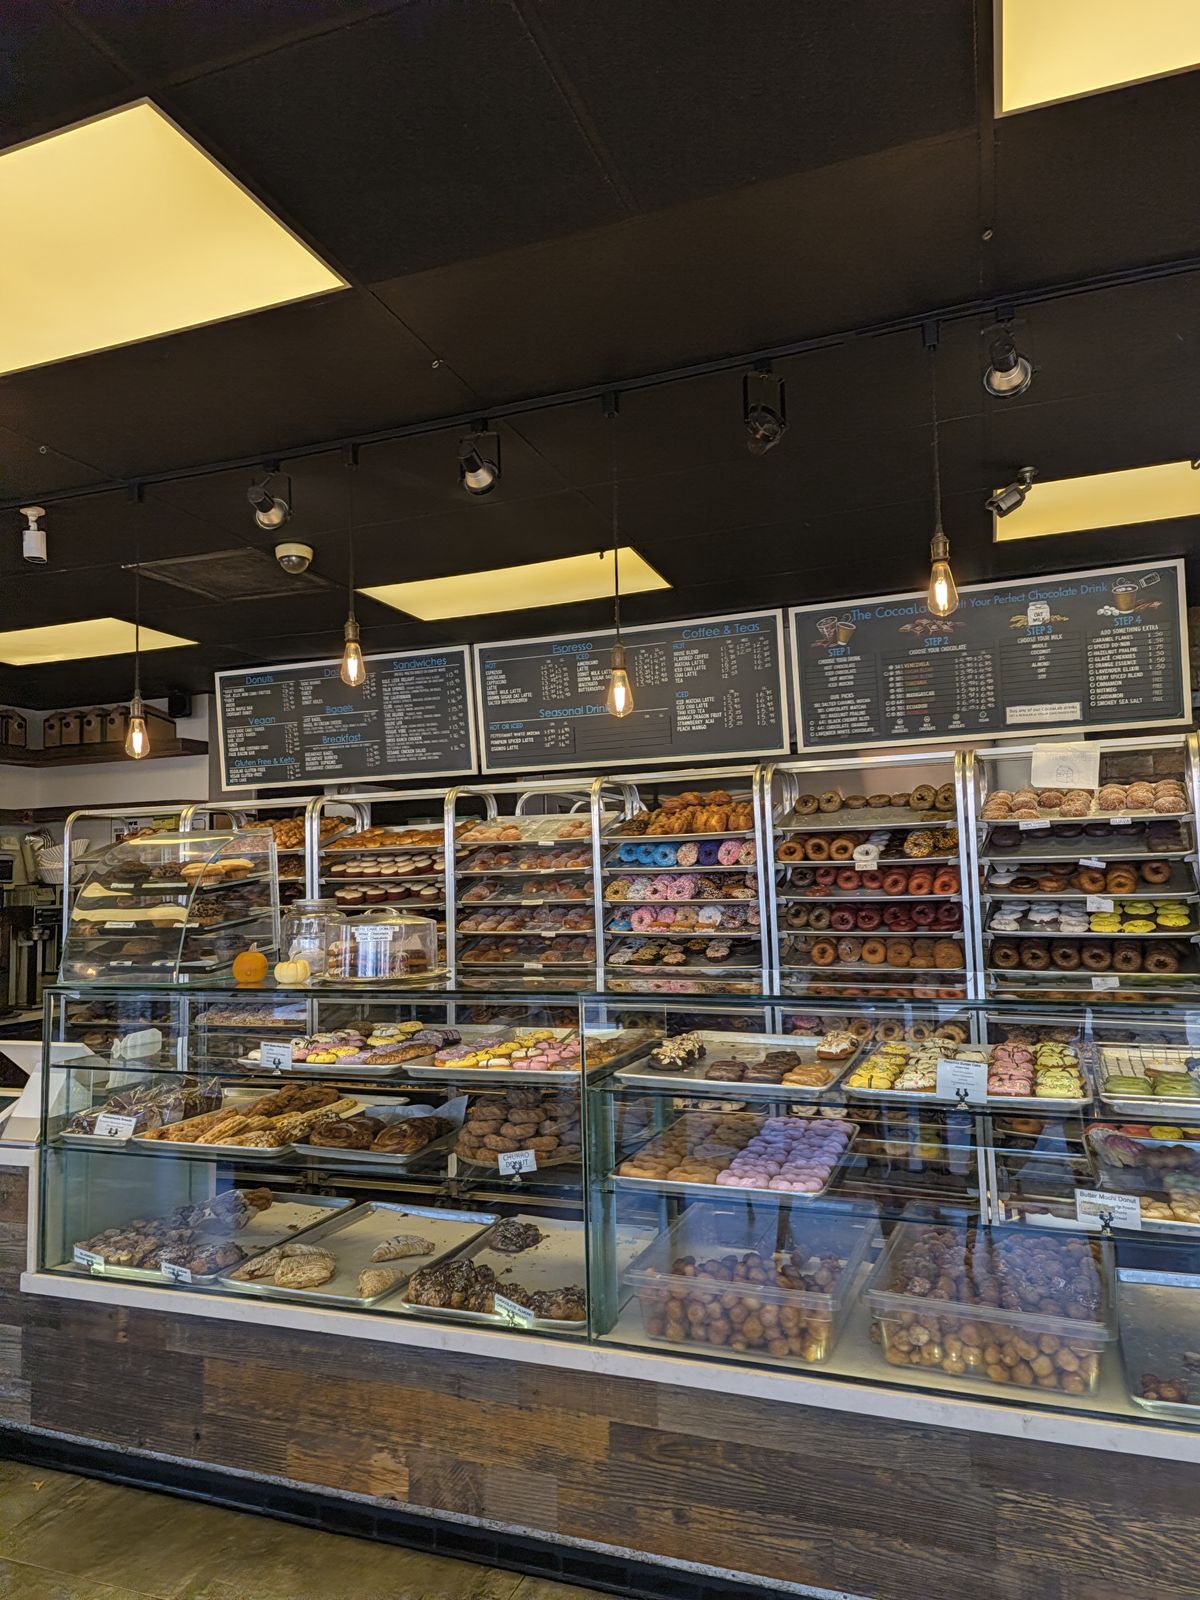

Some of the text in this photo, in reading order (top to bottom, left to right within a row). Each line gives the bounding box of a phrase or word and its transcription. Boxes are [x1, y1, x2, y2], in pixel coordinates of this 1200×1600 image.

[850, 608, 871, 621] The
[970, 596, 990, 607] Your
[993, 592, 1025, 604] Perfect
[1028, 585, 1077, 600] Chocolate
[1080, 581, 1108, 594] Drink
[1113, 615, 1142, 626] STEP 4
[681, 621, 760, 639] Coffee & Teas
[1025, 624, 1052, 636] STEP 3
[1112, 625, 1140, 634] SOMETHING
[1142, 623, 1158, 631] EXTRA
[924, 636, 949, 646] STEP 2
[1017, 636, 1036, 644] CHOOSE
[552, 640, 592, 654] Espresso
[828, 646, 850, 656] STEP 1
[940, 644, 967, 652] CHOCOLATE
[392, 656, 447, 670] Sandwiches
[245, 674, 273, 684] Donuts
[325, 703, 353, 714] Bagels
[539, 705, 583, 717] Seasonal
[248, 715, 275, 726] Vegan
[322, 733, 360, 743] Breakfast
[234, 758, 256, 767] Gluten
[257, 757, 271, 765] Free
[279, 756, 295, 764] Keto
[503, 1152, 529, 1161] CHURRO
[1118, 1196, 1136, 1204] Donut
